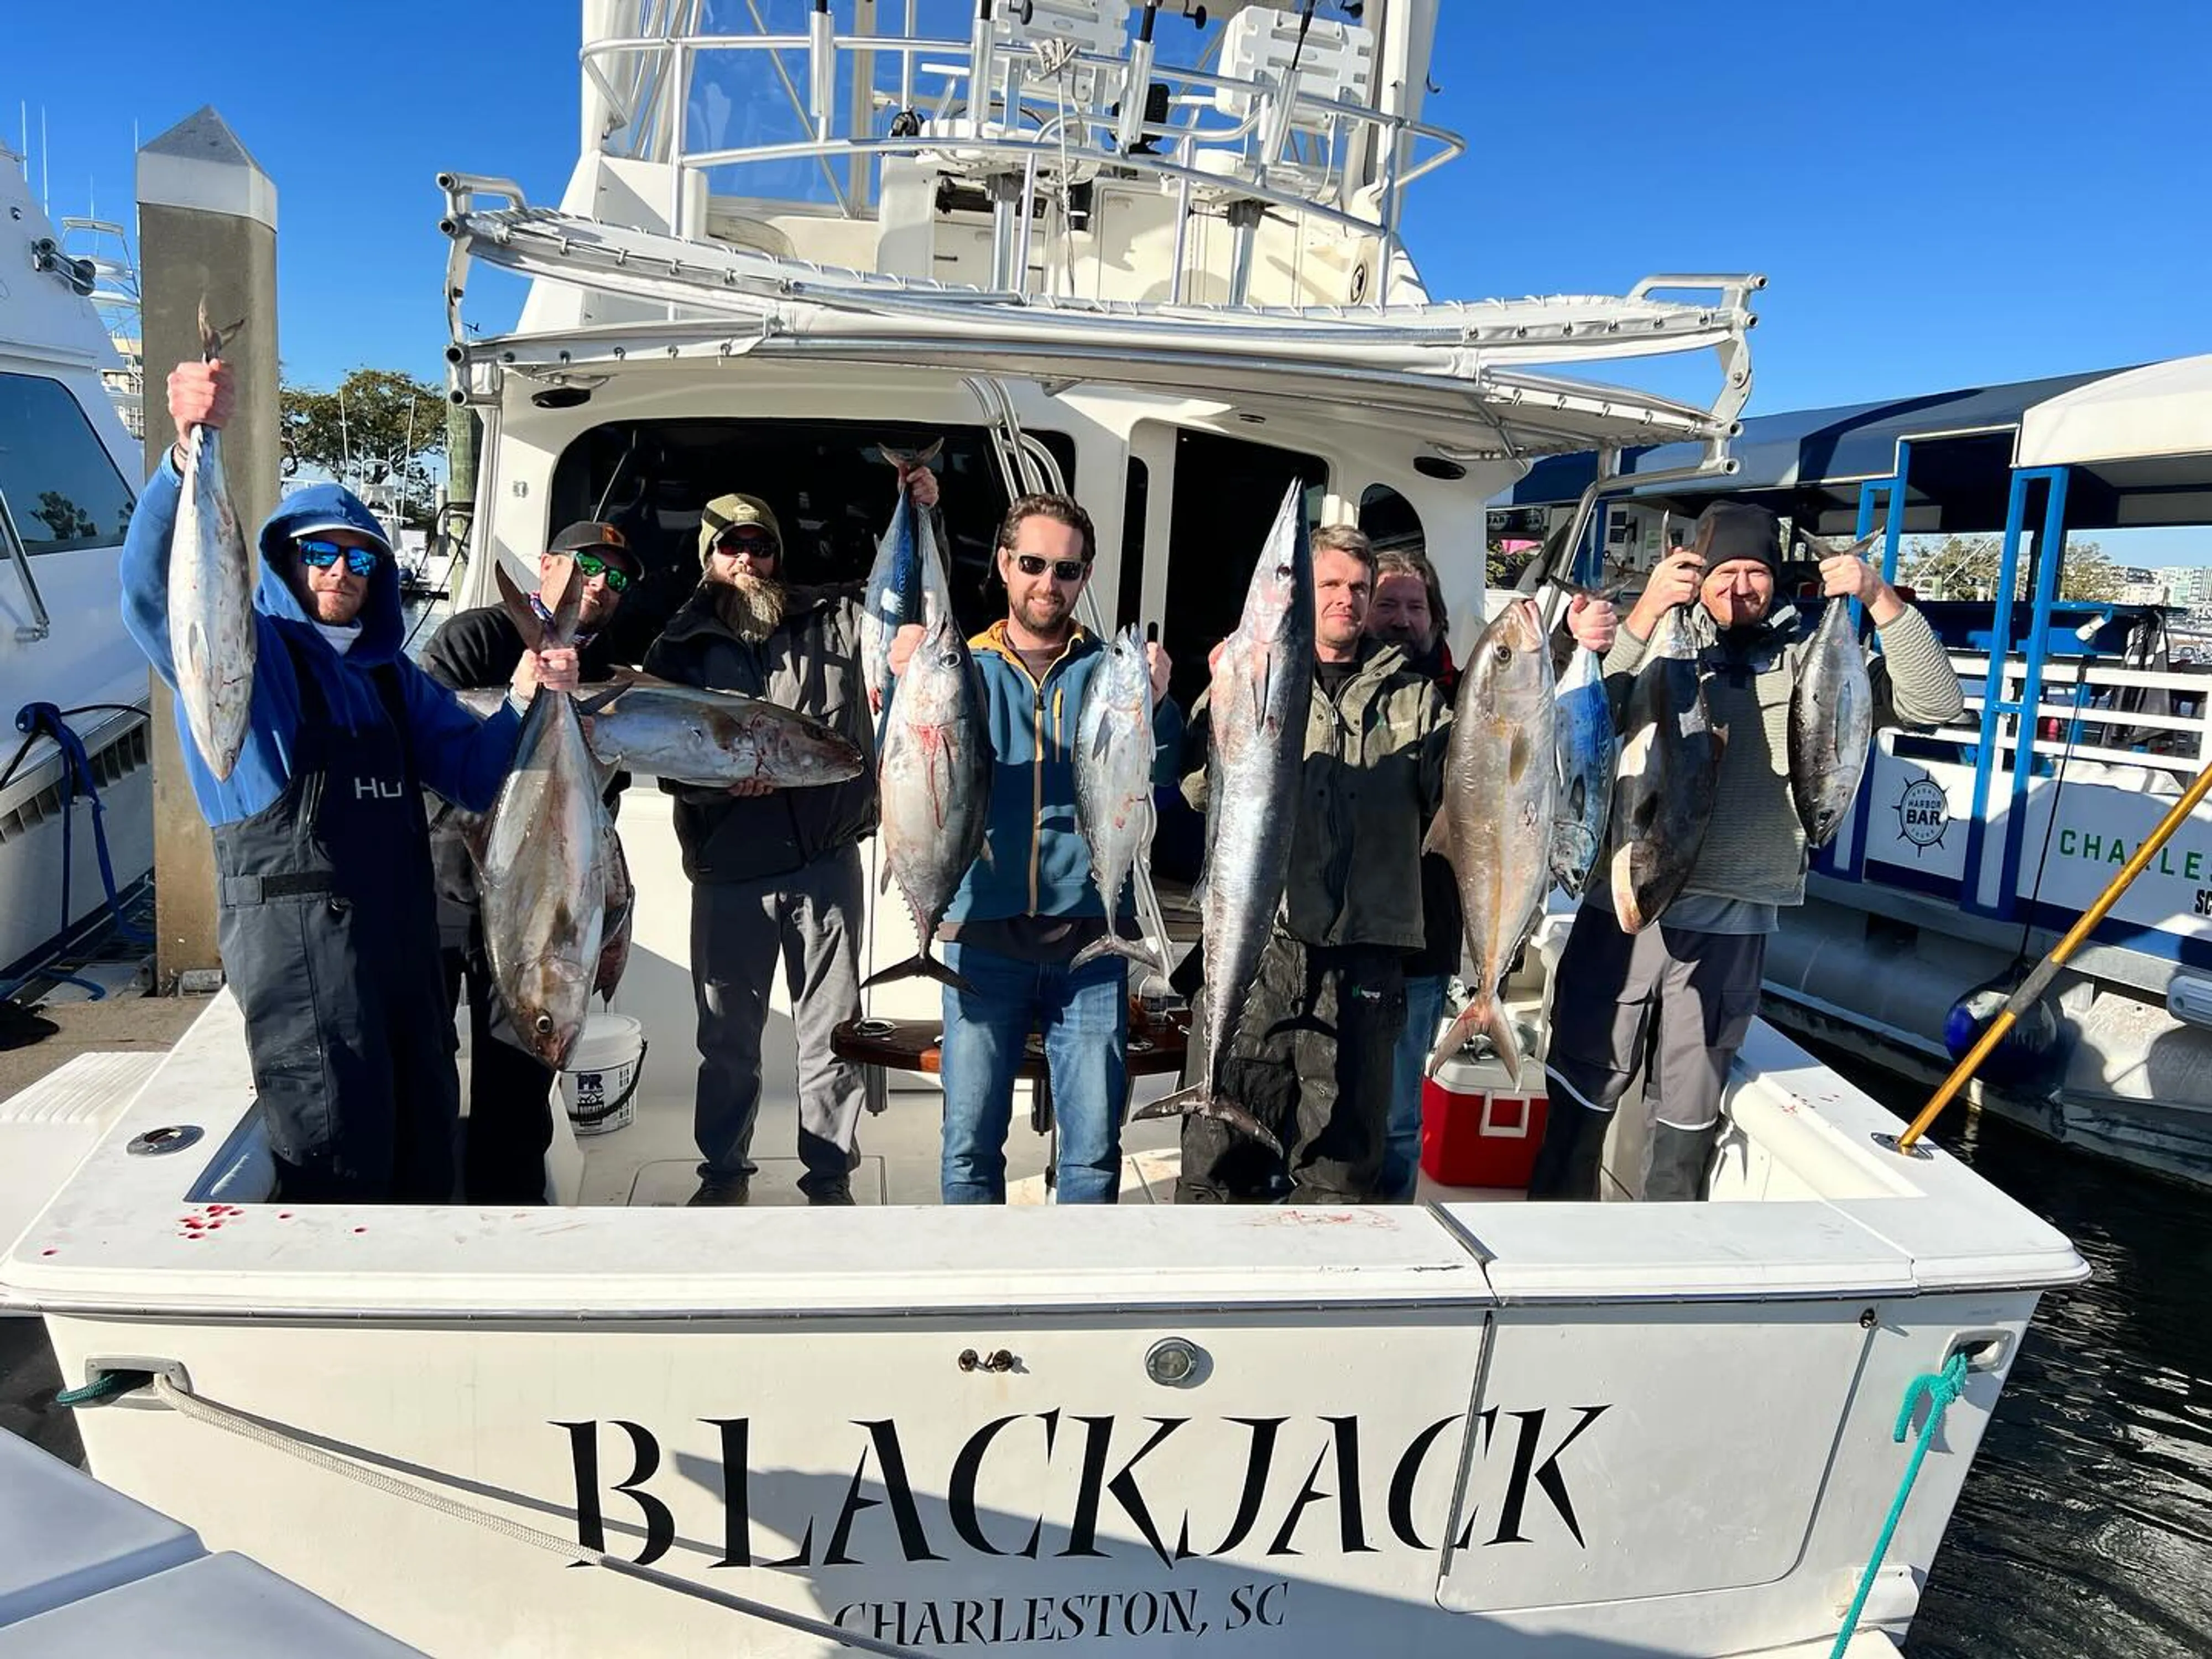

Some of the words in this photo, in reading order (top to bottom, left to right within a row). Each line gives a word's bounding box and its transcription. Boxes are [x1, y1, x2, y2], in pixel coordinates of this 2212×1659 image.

[1906, 808, 1941, 825] BAR
[2059, 829, 2212, 881] CHALE
[546, 1404, 1614, 1570] BLACKJACK
[834, 1588, 1209, 1647] CHARLESTON,
[1225, 1582, 1288, 1632] SC
